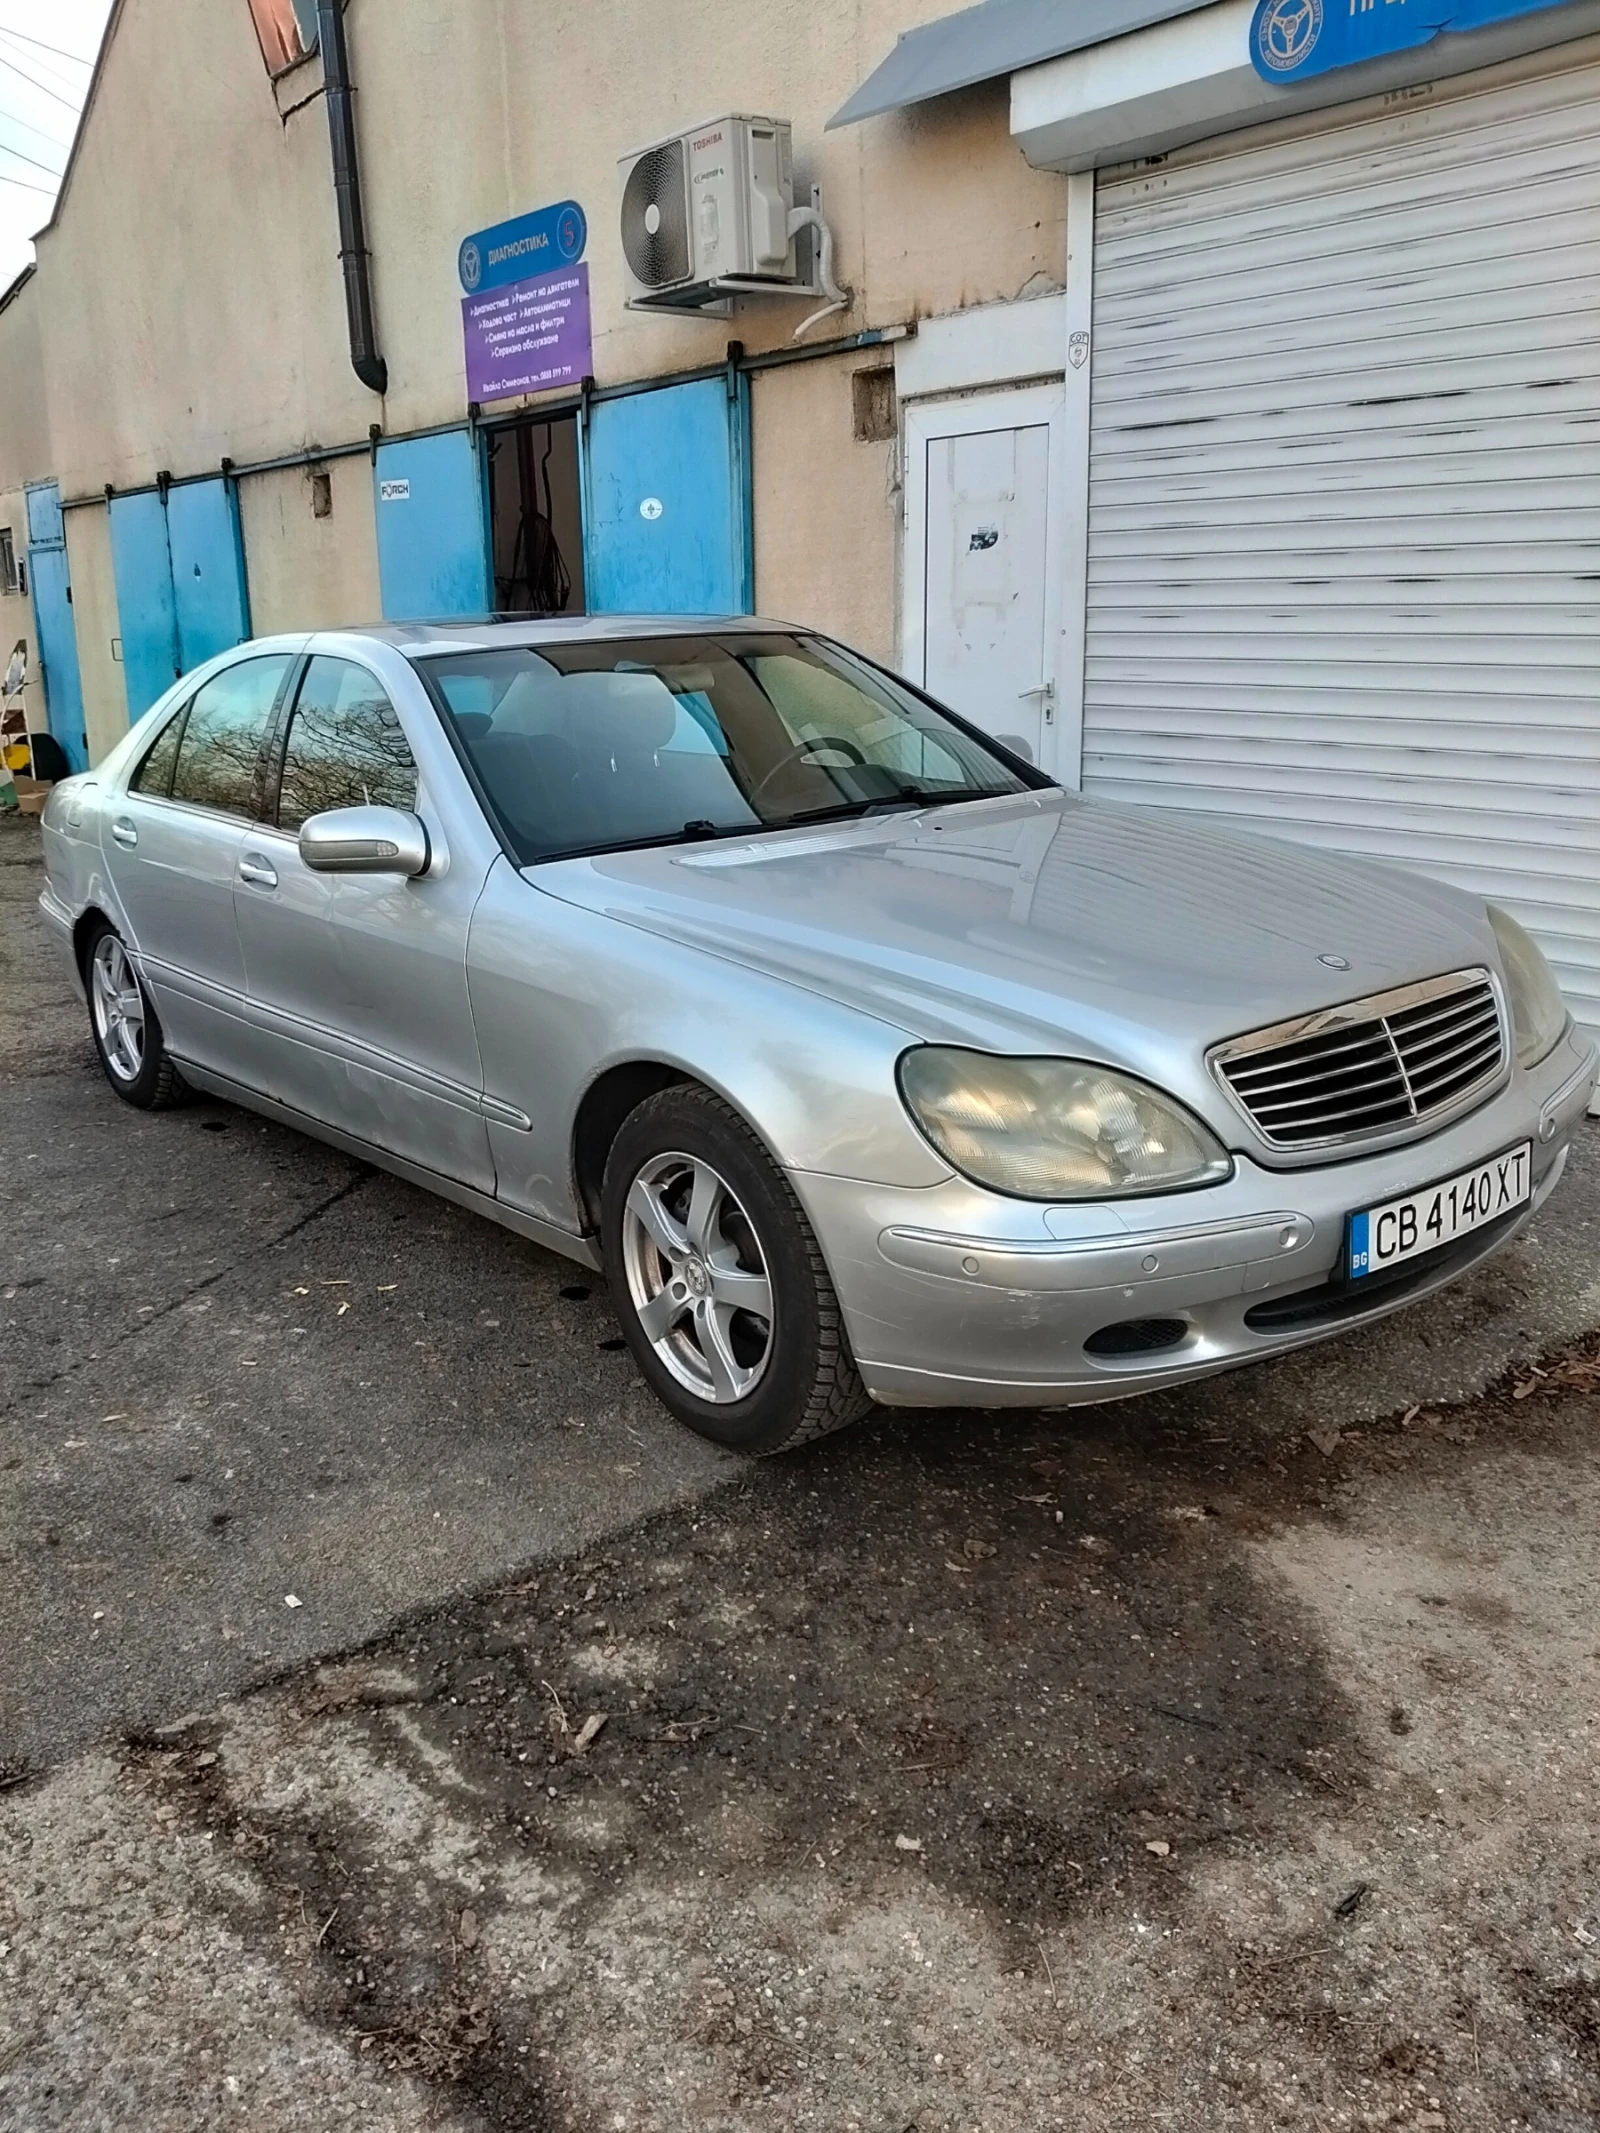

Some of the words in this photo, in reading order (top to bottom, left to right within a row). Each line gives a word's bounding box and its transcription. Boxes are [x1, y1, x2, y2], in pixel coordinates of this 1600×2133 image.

[693, 132, 723, 151] TOSHIBA
[488, 232, 549, 266] ДИАГНОСТИКА
[563, 220, 574, 247] 5
[1376, 1203, 1418, 1259] CB
[1426, 1171, 1491, 1239] 4140
[1496, 1151, 1526, 1210] XT
[1353, 1252, 1368, 1270] BG
